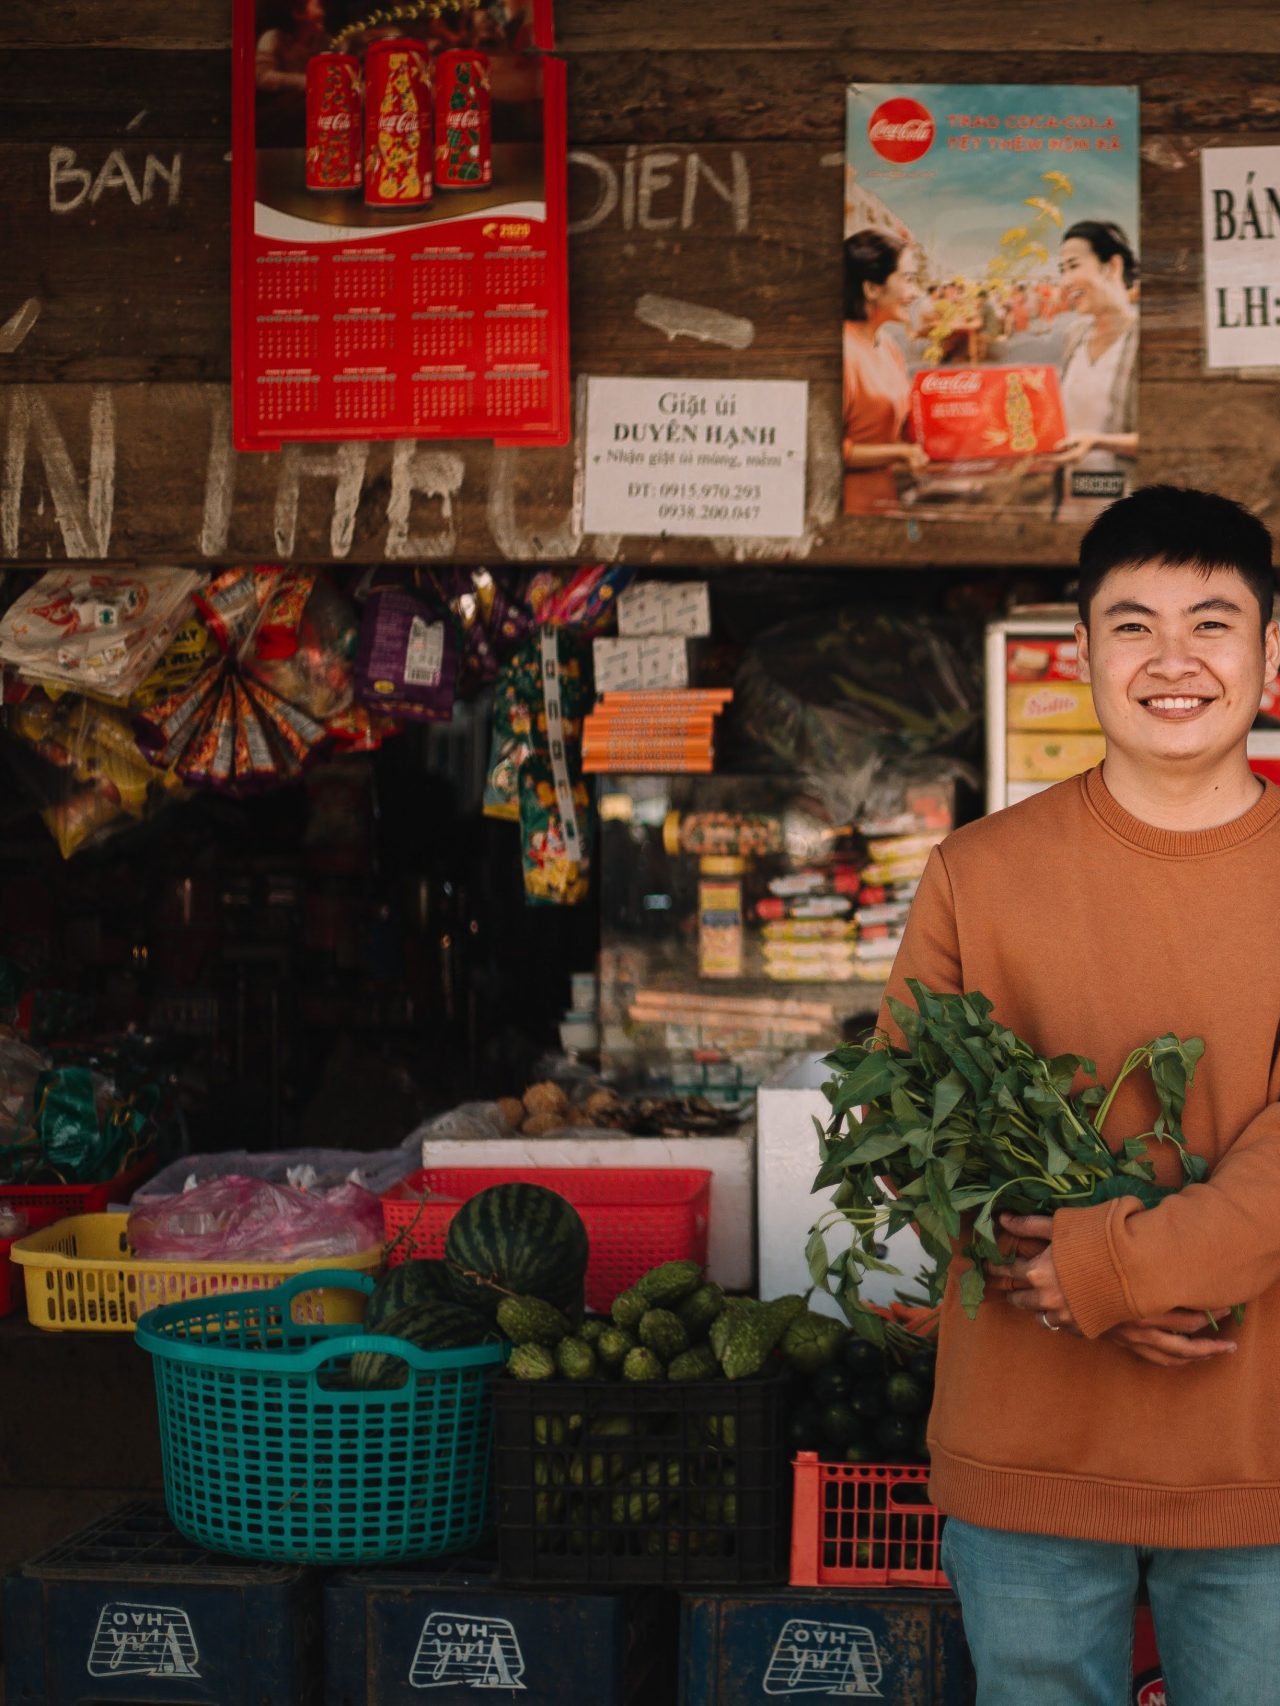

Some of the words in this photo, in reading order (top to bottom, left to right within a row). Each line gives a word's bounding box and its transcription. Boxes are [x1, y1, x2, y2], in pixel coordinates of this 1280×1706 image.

[947, 114, 1000, 129] TRAO
[658, 391, 707, 419] Giặt
[613, 418, 698, 443] DUYÊN
[704, 424, 776, 449] HẠNH
